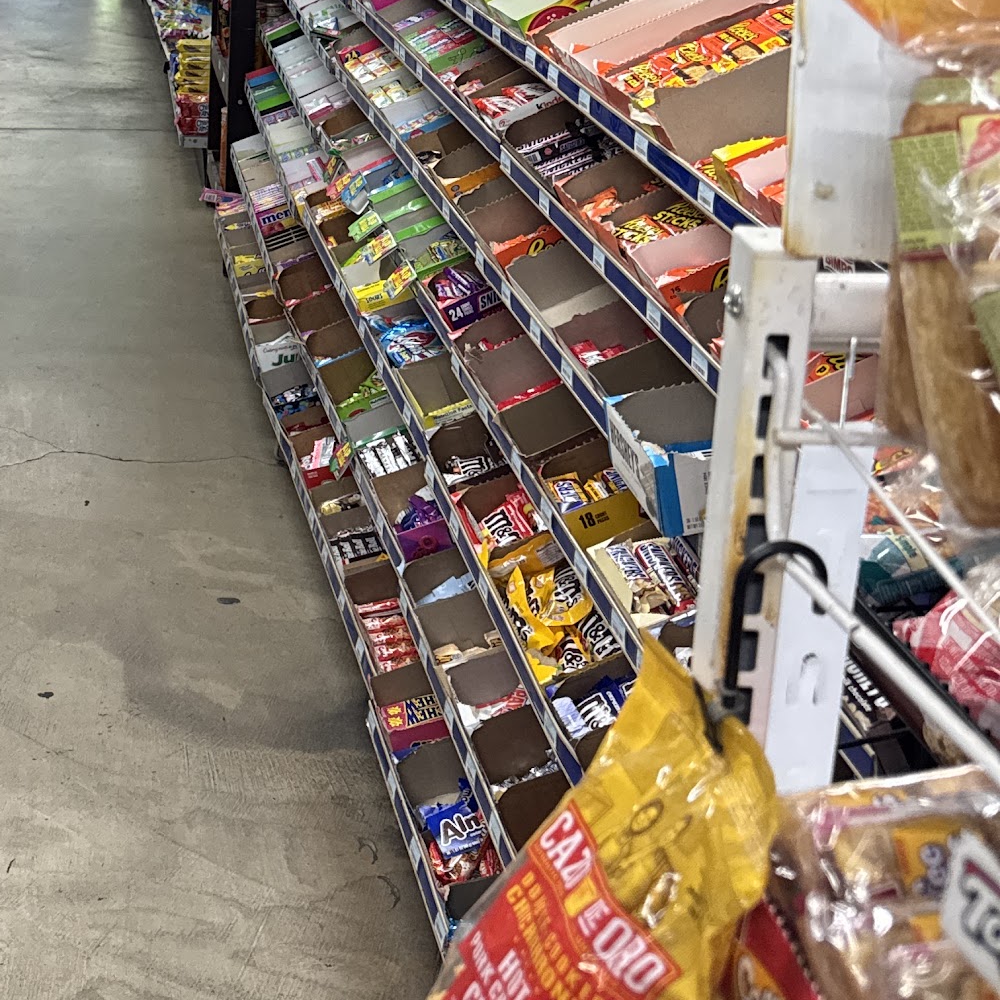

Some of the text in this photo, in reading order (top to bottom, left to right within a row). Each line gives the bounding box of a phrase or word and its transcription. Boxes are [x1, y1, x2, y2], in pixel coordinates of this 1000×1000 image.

[262, 208, 292, 227] men
[448, 308, 465, 323] 24
[578, 512, 596, 529] 18
[577, 898, 612, 938] DE
[469, 930, 497, 986] PORK
[497, 948, 533, 1000] HOT
[592, 917, 667, 995] ORO
